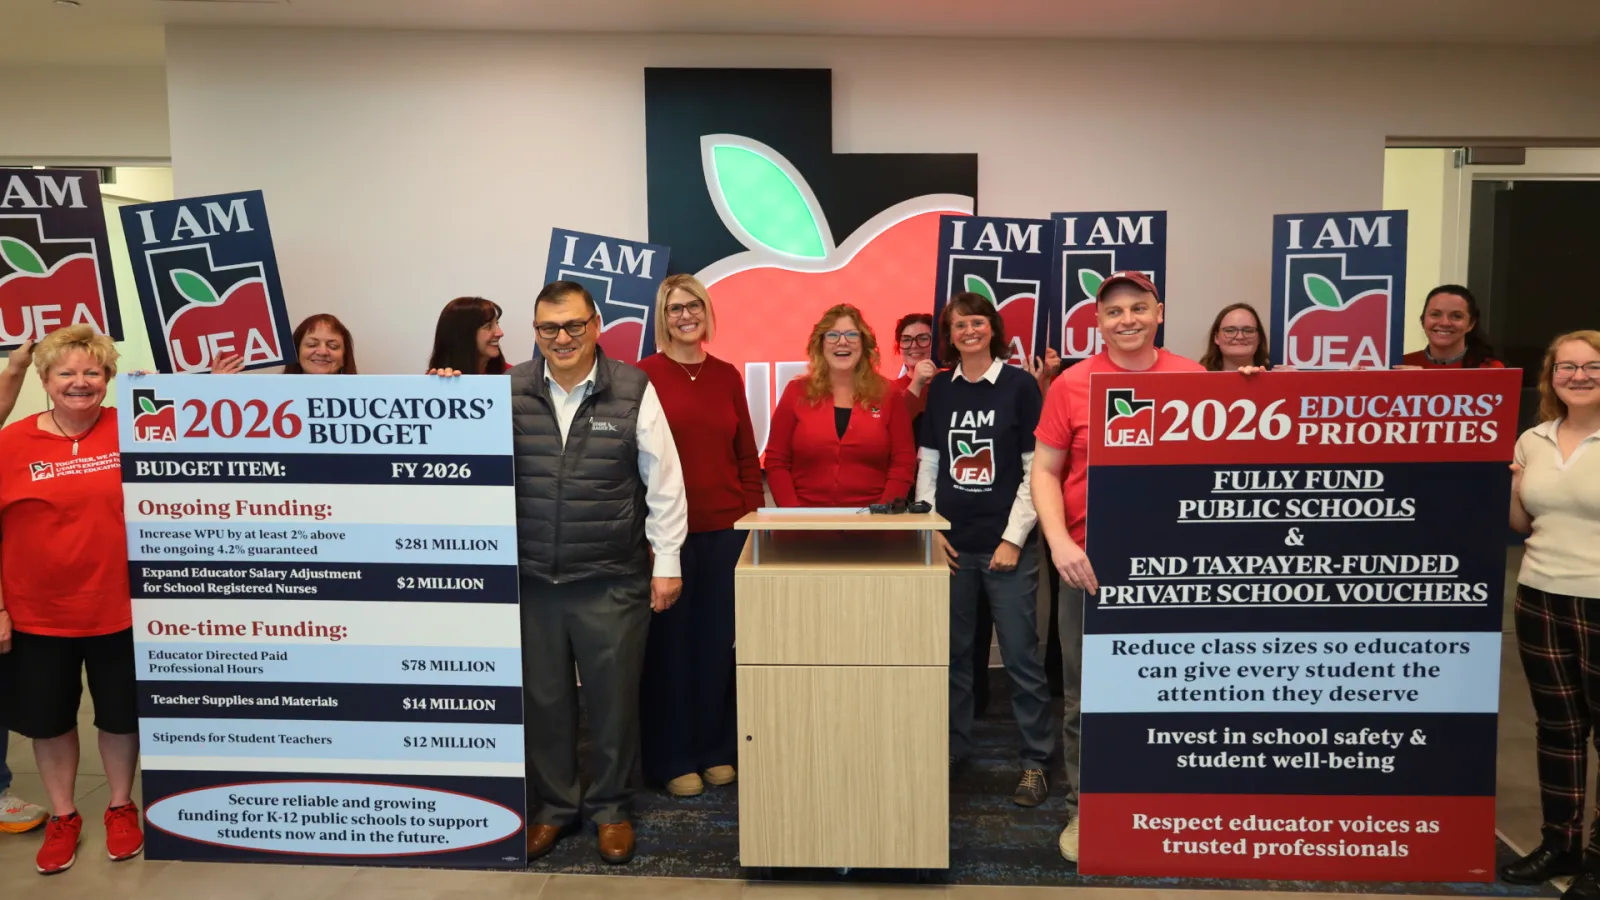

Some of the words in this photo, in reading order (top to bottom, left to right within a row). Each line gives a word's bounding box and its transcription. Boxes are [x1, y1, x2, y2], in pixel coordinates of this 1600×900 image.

[0, 175, 88, 208] AM
[136, 209, 160, 244] I
[171, 198, 254, 241] AM
[1062, 217, 1078, 246] I
[1086, 216, 1154, 245] AM
[950, 220, 967, 250] I
[973, 222, 1042, 253] AM
[1286, 219, 1304, 250] I
[1312, 216, 1392, 249] AM
[560, 235, 580, 267] I
[584, 241, 656, 280] AM
[171, 328, 279, 371] UEA
[1289, 336, 1385, 368] UEA
[307, 398, 493, 419] EDUCATORS’
[1298, 394, 1502, 418] EDUCATORS’
[182, 399, 302, 439] 2026
[950, 411, 957, 428] I
[960, 410, 995, 428] AM
[1159, 399, 1291, 441] 2026
[135, 426, 175, 441] UEA
[308, 423, 432, 444] BUDGET
[1108, 429, 1150, 445] UEA
[1297, 421, 1497, 445] PRIORITIES
[57, 469, 82, 477] PUBLIC
[136, 461, 223, 476] BUDGET
[227, 461, 286, 476] ITEM:
[391, 463, 418, 478] FY
[423, 463, 471, 478] 2026
[953, 467, 991, 483] UEA
[1213, 470, 1300, 490] FULLY
[1304, 470, 1384, 489] FUND
[138, 499, 231, 519] Ongoing
[236, 499, 332, 520] Funding:
[1178, 499, 1280, 519] PUBLIC
[1285, 498, 1415, 518] SCHOOLS
[140, 529, 192, 539] Increase
[194, 529, 224, 539] WPU
[227, 529, 242, 541] by
[245, 530, 256, 539] at
[259, 529, 287, 539] least
[291, 530, 308, 539] 2%
[310, 530, 346, 540] above
[395, 538, 428, 550] $281
[432, 539, 498, 551] MILLION
[1284, 527, 1304, 546] &
[140, 544, 161, 554] the
[163, 544, 214, 556] ongoing
[217, 545, 245, 554] 4.2%
[248, 545, 318, 556] guaranteed
[142, 567, 189, 579] Expand
[191, 567, 247, 578] Educator
[249, 568, 287, 580] Salary
[289, 568, 362, 580] Adjustment
[1129, 557, 1188, 576] END
[1193, 555, 1459, 575] TAXPAYER-FUNDED
[143, 582, 162, 592] for
[163, 582, 205, 593] School
[207, 582, 273, 595] Registered
[275, 584, 317, 594] Nurses
[397, 576, 415, 589] $2
[418, 577, 484, 590] MILLION
[1099, 584, 1211, 604] PRIVATE
[1217, 583, 1330, 603] SCHOOL
[1336, 583, 1488, 602] VOUCHERS
[147, 619, 246, 636] One-time
[252, 620, 347, 641] Funding:
[148, 650, 203, 660] Educator
[206, 650, 258, 660] Directed
[261, 651, 288, 661] Paid
[1112, 639, 1195, 655] Reduce
[1201, 638, 1256, 654] class
[1262, 637, 1317, 654] sizes
[1323, 642, 1348, 654] so
[1354, 638, 1470, 654] educators
[149, 663, 224, 673] Professional
[227, 664, 264, 674] Hours
[402, 659, 426, 671] $78
[430, 660, 495, 672] MILLION
[1138, 666, 1177, 678] can
[1184, 661, 1231, 682] give
[1237, 666, 1300, 681] every
[1305, 662, 1395, 678] student
[1403, 662, 1440, 678] the
[151, 695, 201, 705] Teacher
[202, 695, 254, 707] Supplies
[256, 696, 279, 706] and
[282, 696, 338, 707] Materials
[403, 697, 427, 710] $14
[430, 698, 496, 711] MILLION
[1157, 685, 1264, 701] attention
[1272, 685, 1323, 705] they
[1329, 685, 1419, 702] deserve
[153, 732, 206, 744] Stipends
[208, 733, 226, 742] for
[228, 734, 275, 743] Student
[278, 734, 332, 744] Teachers
[404, 736, 427, 748] $12
[431, 737, 496, 748] MILLION
[1147, 728, 1217, 744] Invest
[1223, 727, 1246, 744] in
[1252, 728, 1328, 745] school
[1334, 728, 1404, 749] safety
[1410, 729, 1426, 745] &
[1177, 751, 1266, 768] student
[1272, 751, 1395, 773] well-being
[229, 794, 279, 806] Secure
[283, 795, 339, 807] reliable
[342, 797, 370, 808] and
[374, 797, 436, 812] growing
[178, 809, 238, 824] funding
[242, 810, 264, 822] for
[267, 811, 298, 823] K-12
[301, 812, 348, 826] public
[351, 813, 407, 826] schools
[410, 816, 425, 826] to
[428, 817, 488, 830] support
[1132, 814, 1223, 834] Respect
[1229, 815, 1334, 832] educator
[1338, 815, 1410, 833] voices
[1415, 820, 1439, 833] as
[217, 827, 282, 839] students
[285, 831, 316, 840] now
[319, 830, 347, 841] and
[351, 829, 366, 842] in
[369, 831, 394, 843] the
[398, 831, 449, 844] future.
[1162, 838, 1247, 854] trusted
[1253, 838, 1408, 859] professionals
